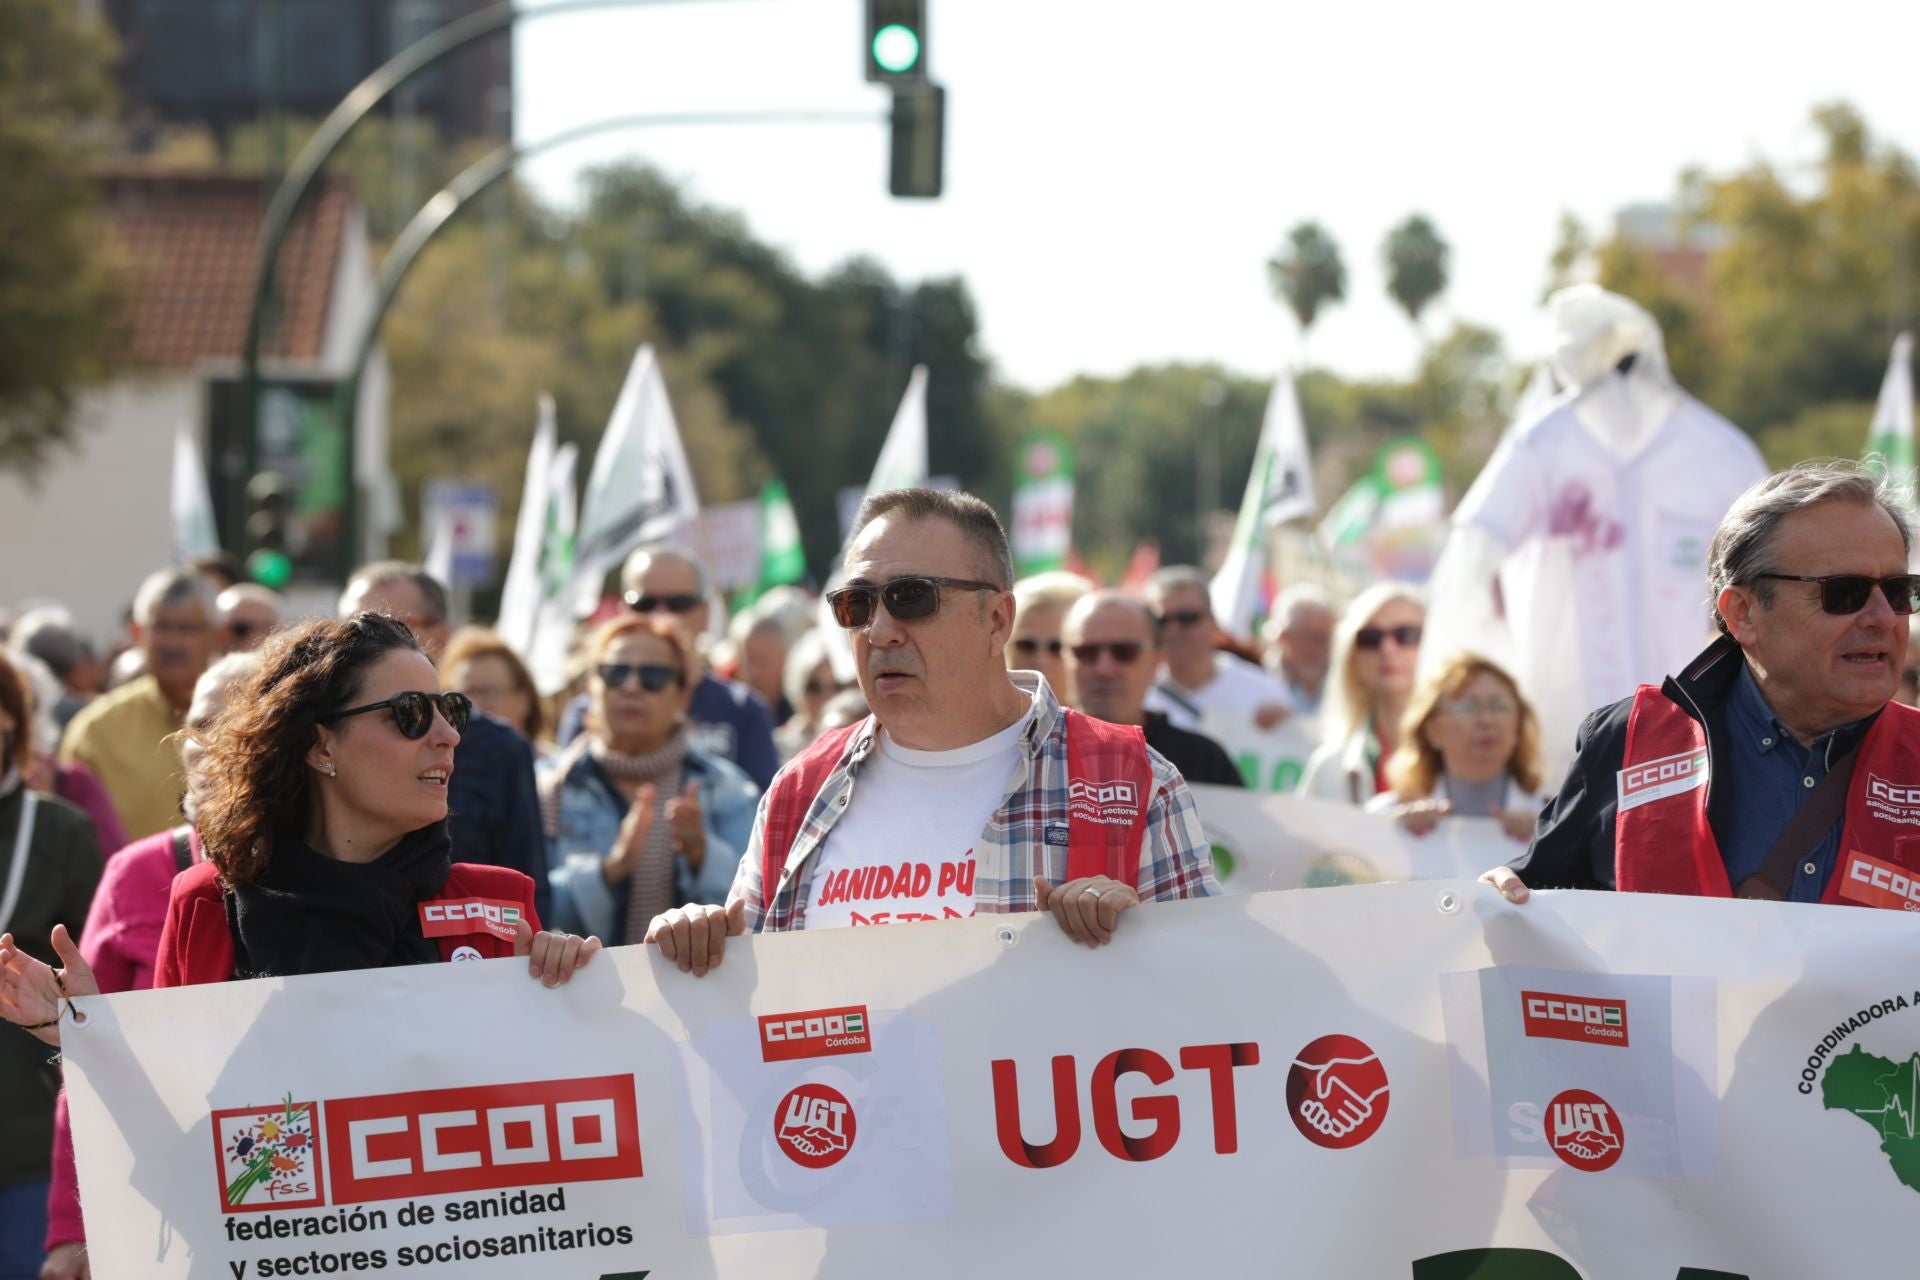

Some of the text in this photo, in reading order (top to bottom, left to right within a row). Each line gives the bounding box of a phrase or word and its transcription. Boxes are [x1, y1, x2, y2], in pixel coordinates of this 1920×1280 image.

[1627, 759, 1692, 789] CCOO
[1069, 783, 1132, 803] CCOO
[1070, 802, 1095, 813] anidad
[1103, 807, 1138, 816] sectores
[1073, 812, 1133, 825] sociosanitarios
[1866, 800, 1900, 814] sanidad
[424, 903, 501, 923] CCOO
[1527, 999, 1603, 1025] CCOO
[765, 1015, 845, 1042] CCOO
[1584, 1025, 1624, 1038] Córdoba
[825, 1036, 866, 1048] Córdoba
[1797, 995, 1909, 1095] COORDINADORA
[785, 1094, 847, 1136] UGT
[991, 1042, 1260, 1168] UGT
[1553, 1103, 1609, 1135] UGT
[348, 1098, 619, 1180] CCOO
[264, 1178, 310, 1201] fss
[225, 1187, 566, 1241] federación de sanidad
[257, 1248, 388, 1278] sectores
[397, 1221, 634, 1267] sociosanitarios
